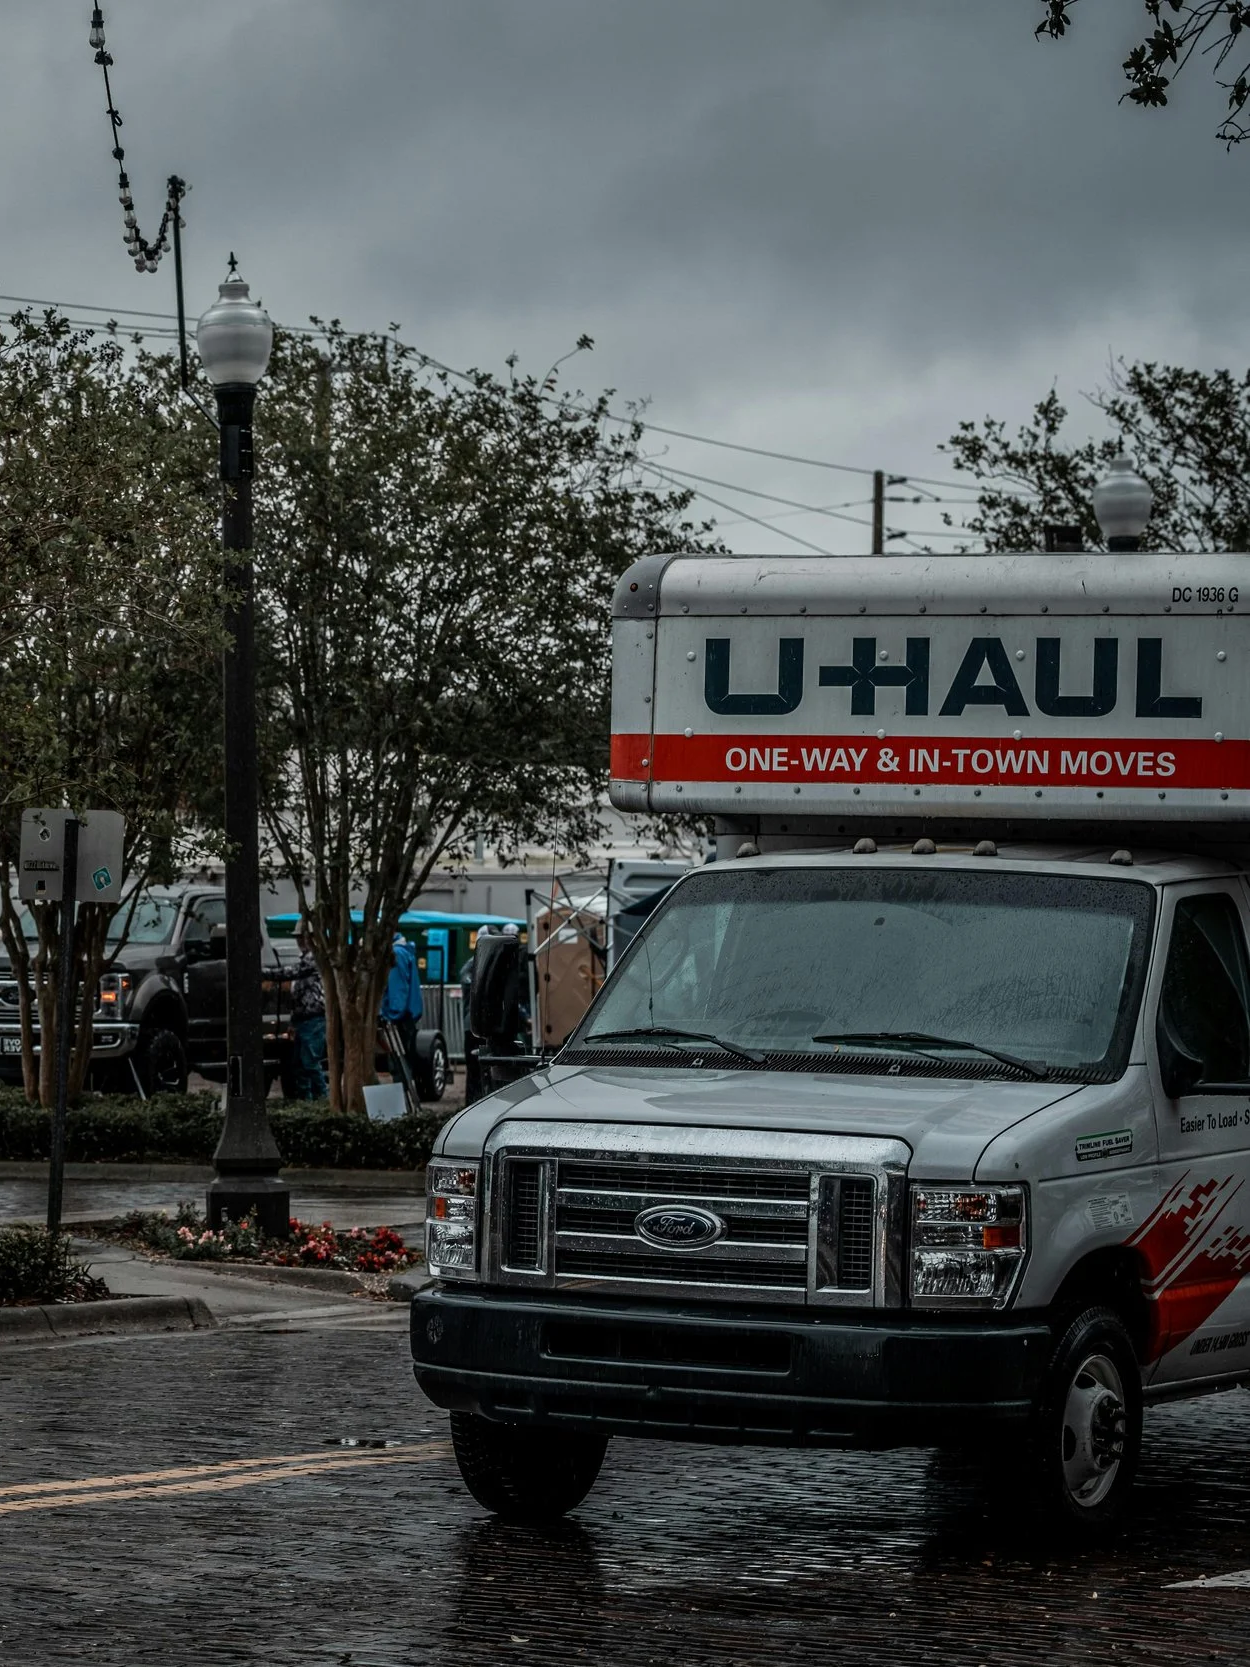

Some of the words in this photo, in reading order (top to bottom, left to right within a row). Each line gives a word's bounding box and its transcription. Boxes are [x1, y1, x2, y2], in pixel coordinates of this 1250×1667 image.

[1172, 587, 1192, 603] DC
[1196, 587, 1225, 602] 1936
[1229, 587, 1239, 602] G
[725, 747, 868, 772] ONE-WAY
[876, 748, 901, 773] &
[908, 748, 1049, 775] IN-TOWN
[1060, 750, 1177, 777] MOVES
[1180, 1115, 1205, 1133] Easier
[1207, 1113, 1217, 1129] To
[1218, 1110, 1238, 1128] Load
[1102, 1138, 1114, 1147] FUEL
[1115, 1135, 1130, 1145] SAVER
[655, 1215, 696, 1235] Ford
